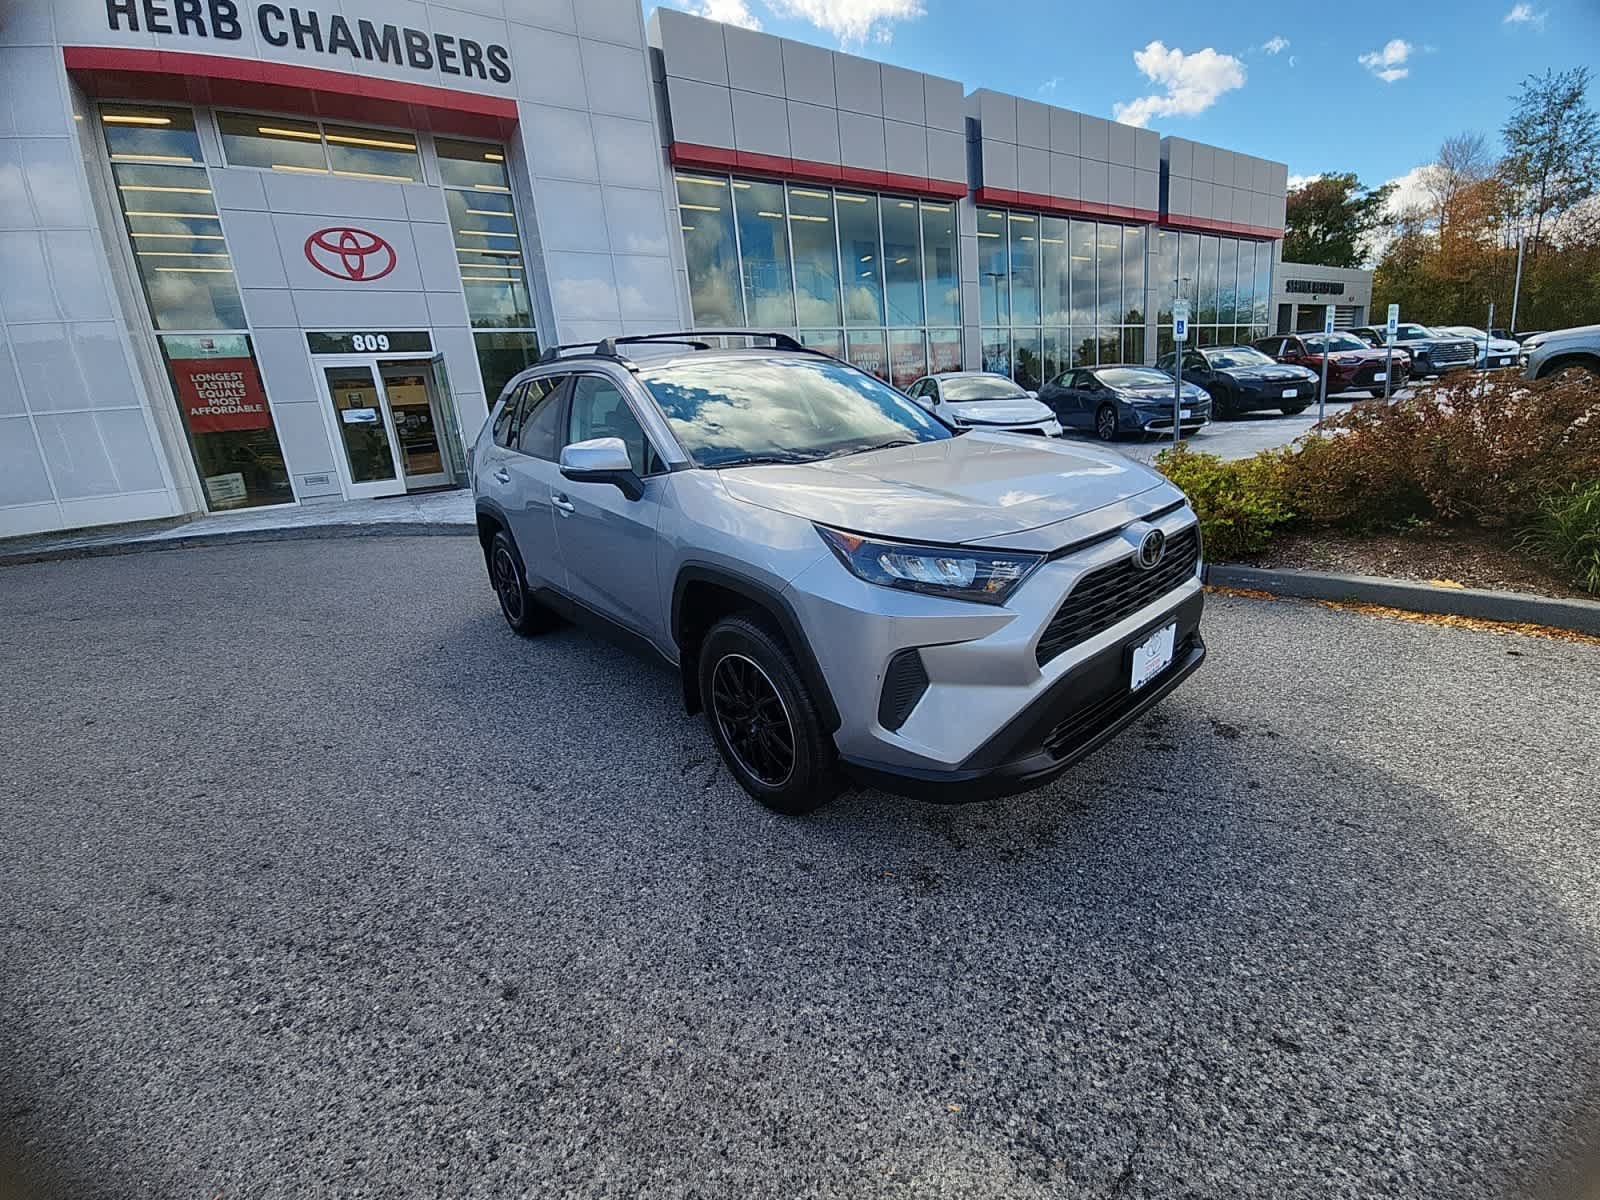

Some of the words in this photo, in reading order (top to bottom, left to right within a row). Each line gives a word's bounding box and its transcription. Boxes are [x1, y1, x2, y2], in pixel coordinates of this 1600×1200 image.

[106, 0, 242, 40] HERB
[257, 4, 512, 84] CHAMBERS
[352, 334, 390, 351] 809
[190, 372, 243, 382] LONGEST
[194, 380, 245, 390] LASTING
[198, 389, 247, 399] EQUALS
[208, 397, 242, 406] MOST
[191, 404, 264, 415] AFFORDABLE
